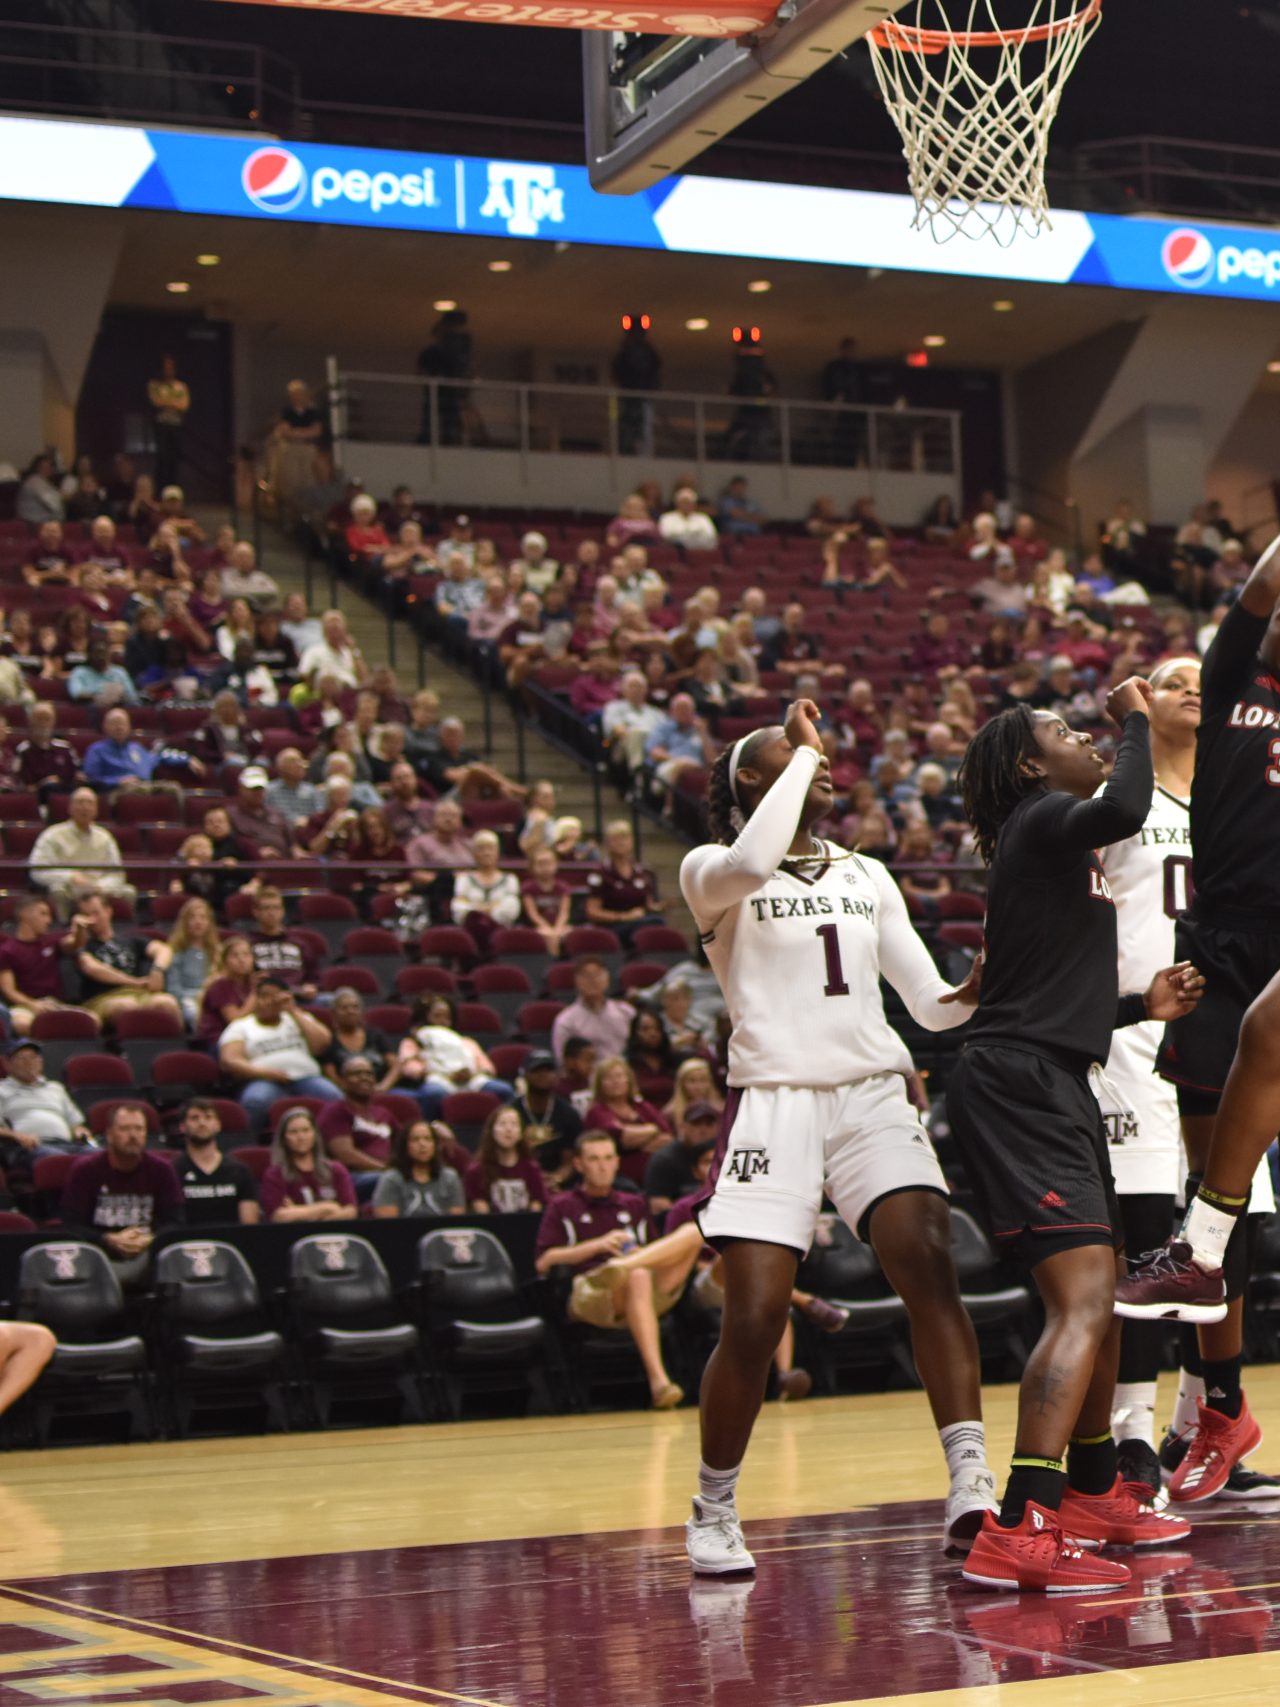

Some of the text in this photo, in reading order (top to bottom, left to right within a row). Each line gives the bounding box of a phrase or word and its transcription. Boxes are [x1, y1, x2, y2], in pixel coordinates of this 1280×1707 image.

[312, 166, 434, 212] pepsi
[751, 895, 876, 924] TEXAS A&M
[1162, 854, 1195, 920] 0
[815, 923, 851, 998] 1
